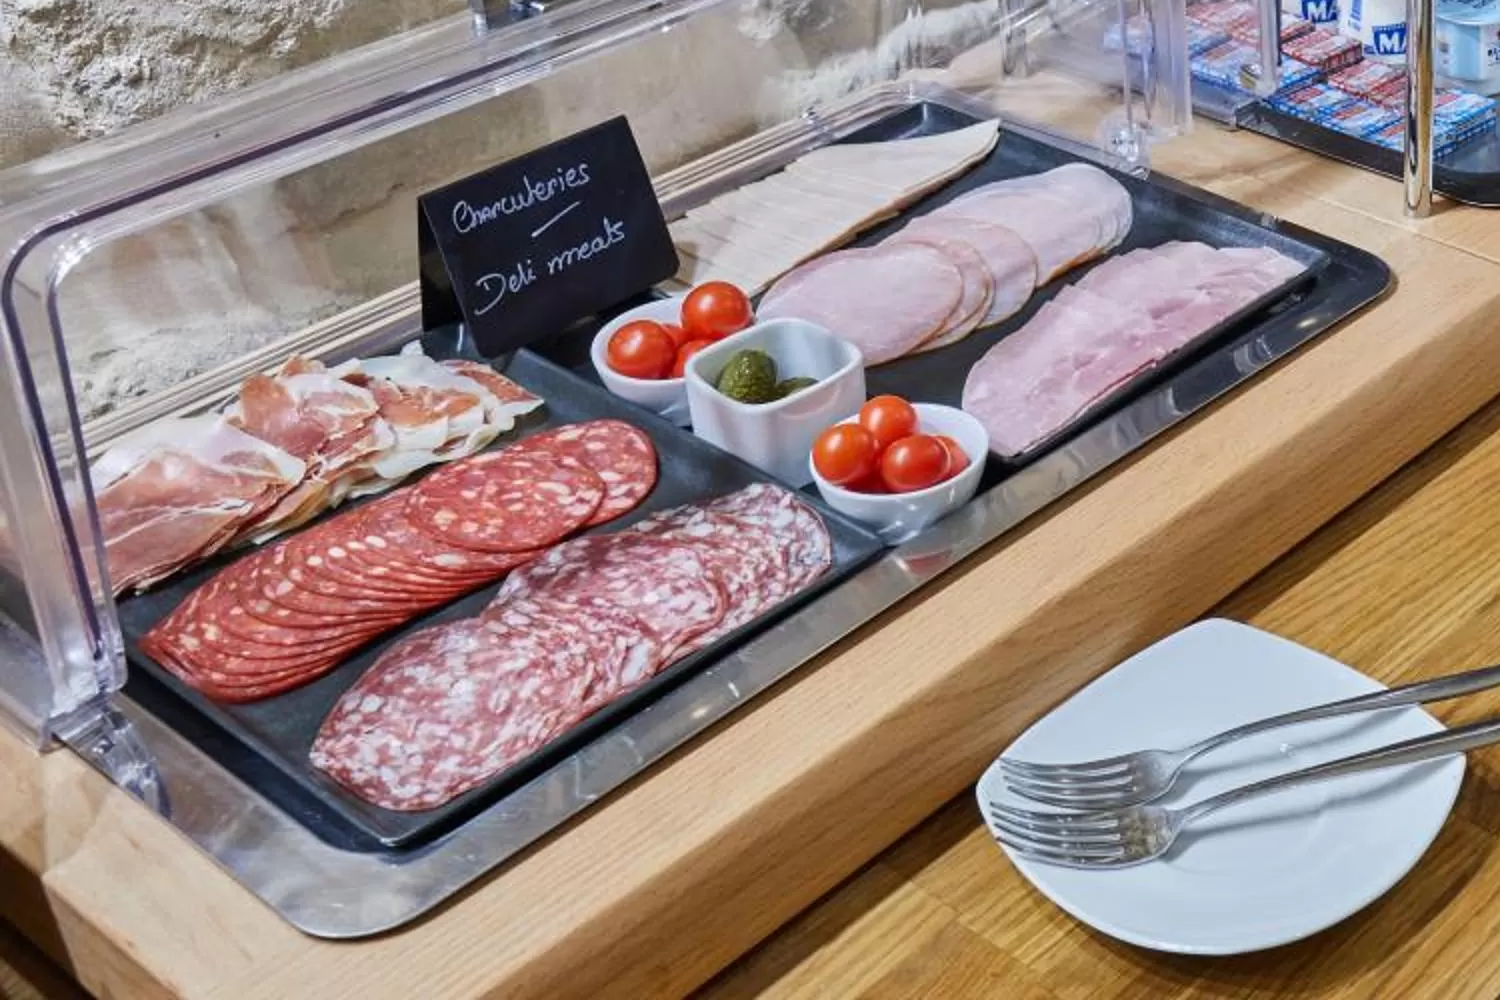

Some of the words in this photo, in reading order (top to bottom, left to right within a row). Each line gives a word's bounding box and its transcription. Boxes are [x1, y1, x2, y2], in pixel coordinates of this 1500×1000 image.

[453, 163, 591, 233] Charcuteries
[474, 259, 537, 316] Deli
[547, 216, 625, 275] meats
